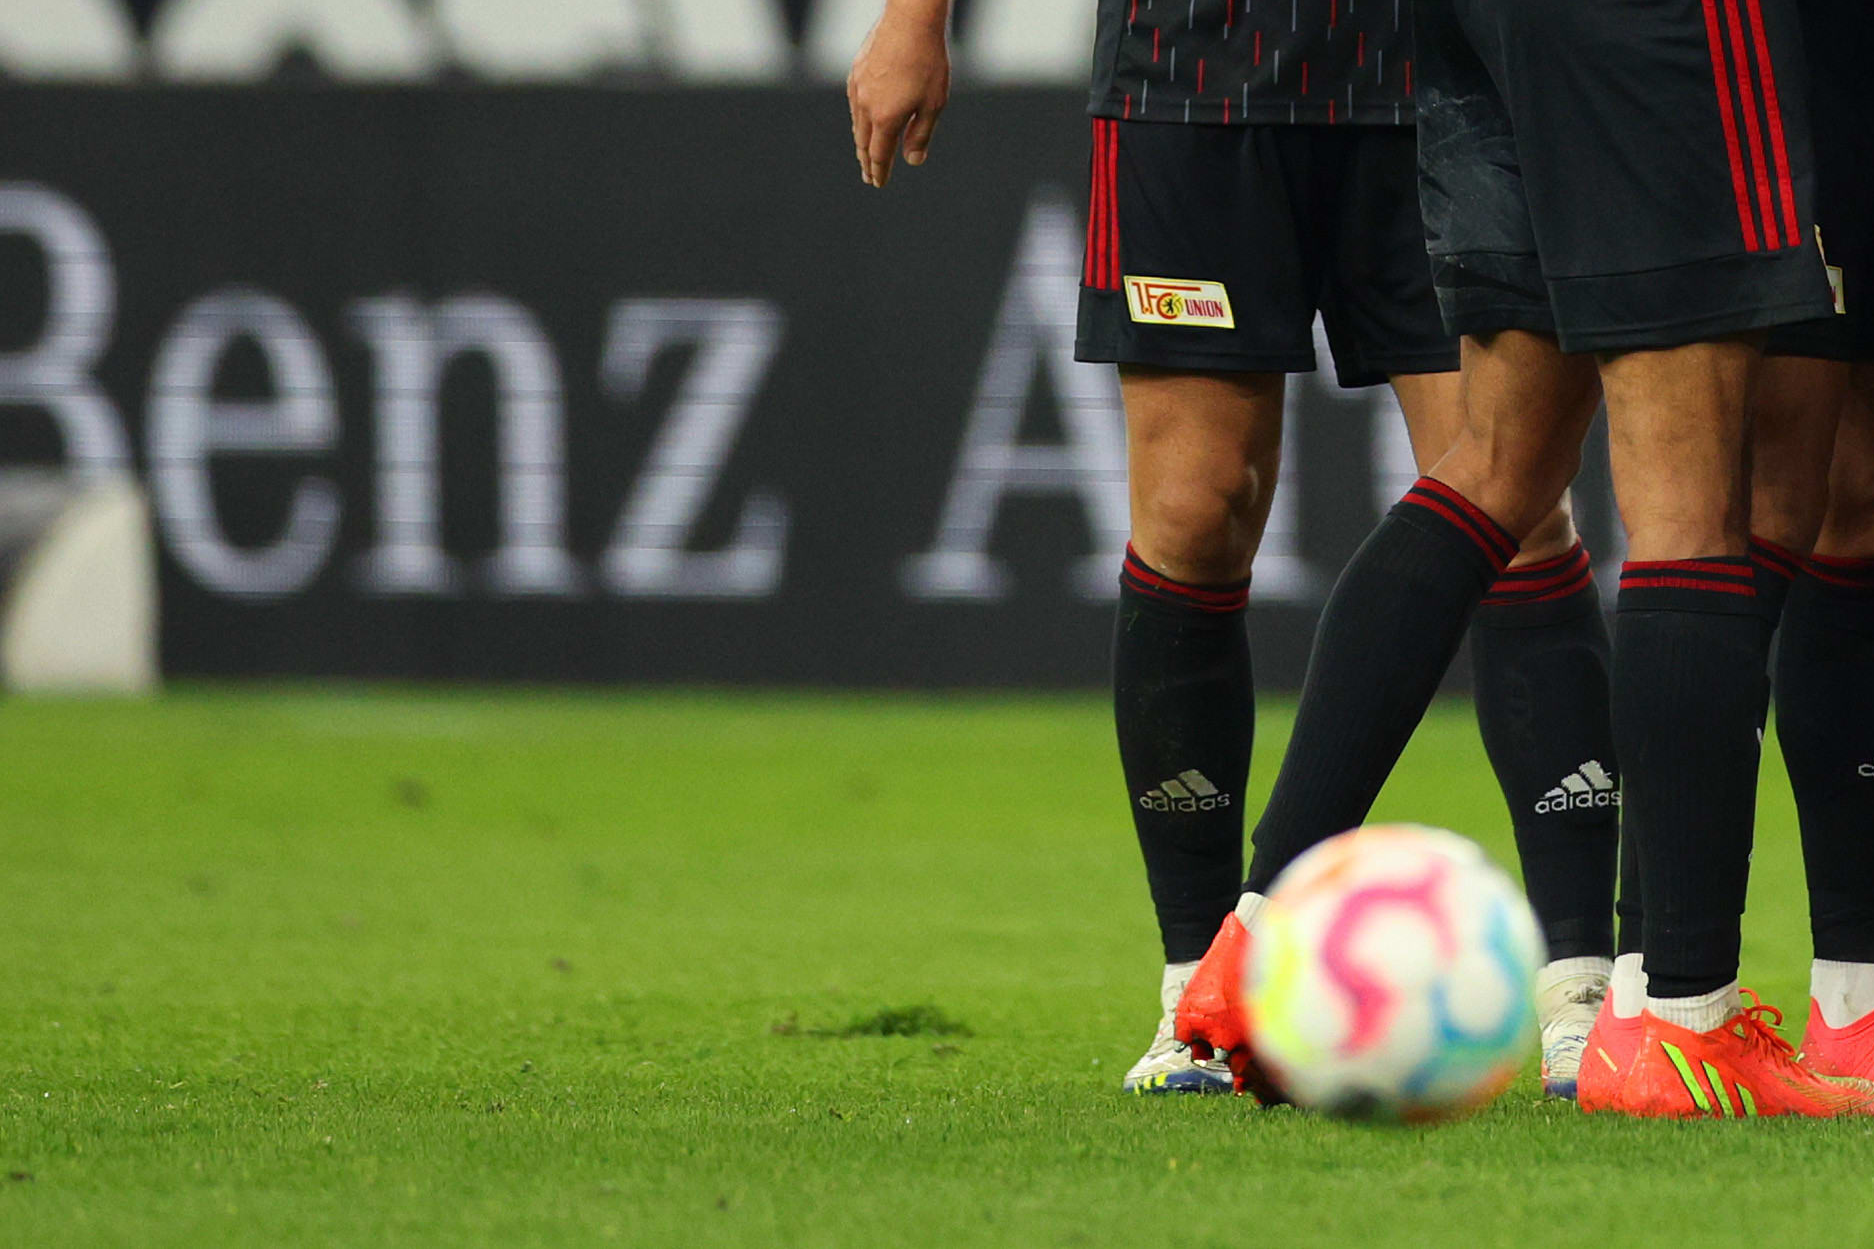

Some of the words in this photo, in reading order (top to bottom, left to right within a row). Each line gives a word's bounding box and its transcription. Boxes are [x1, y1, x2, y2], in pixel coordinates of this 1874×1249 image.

[1184, 298, 1225, 318] UNION
[1138, 793, 1231, 812] adidas
[1534, 789, 1622, 815] adidas
